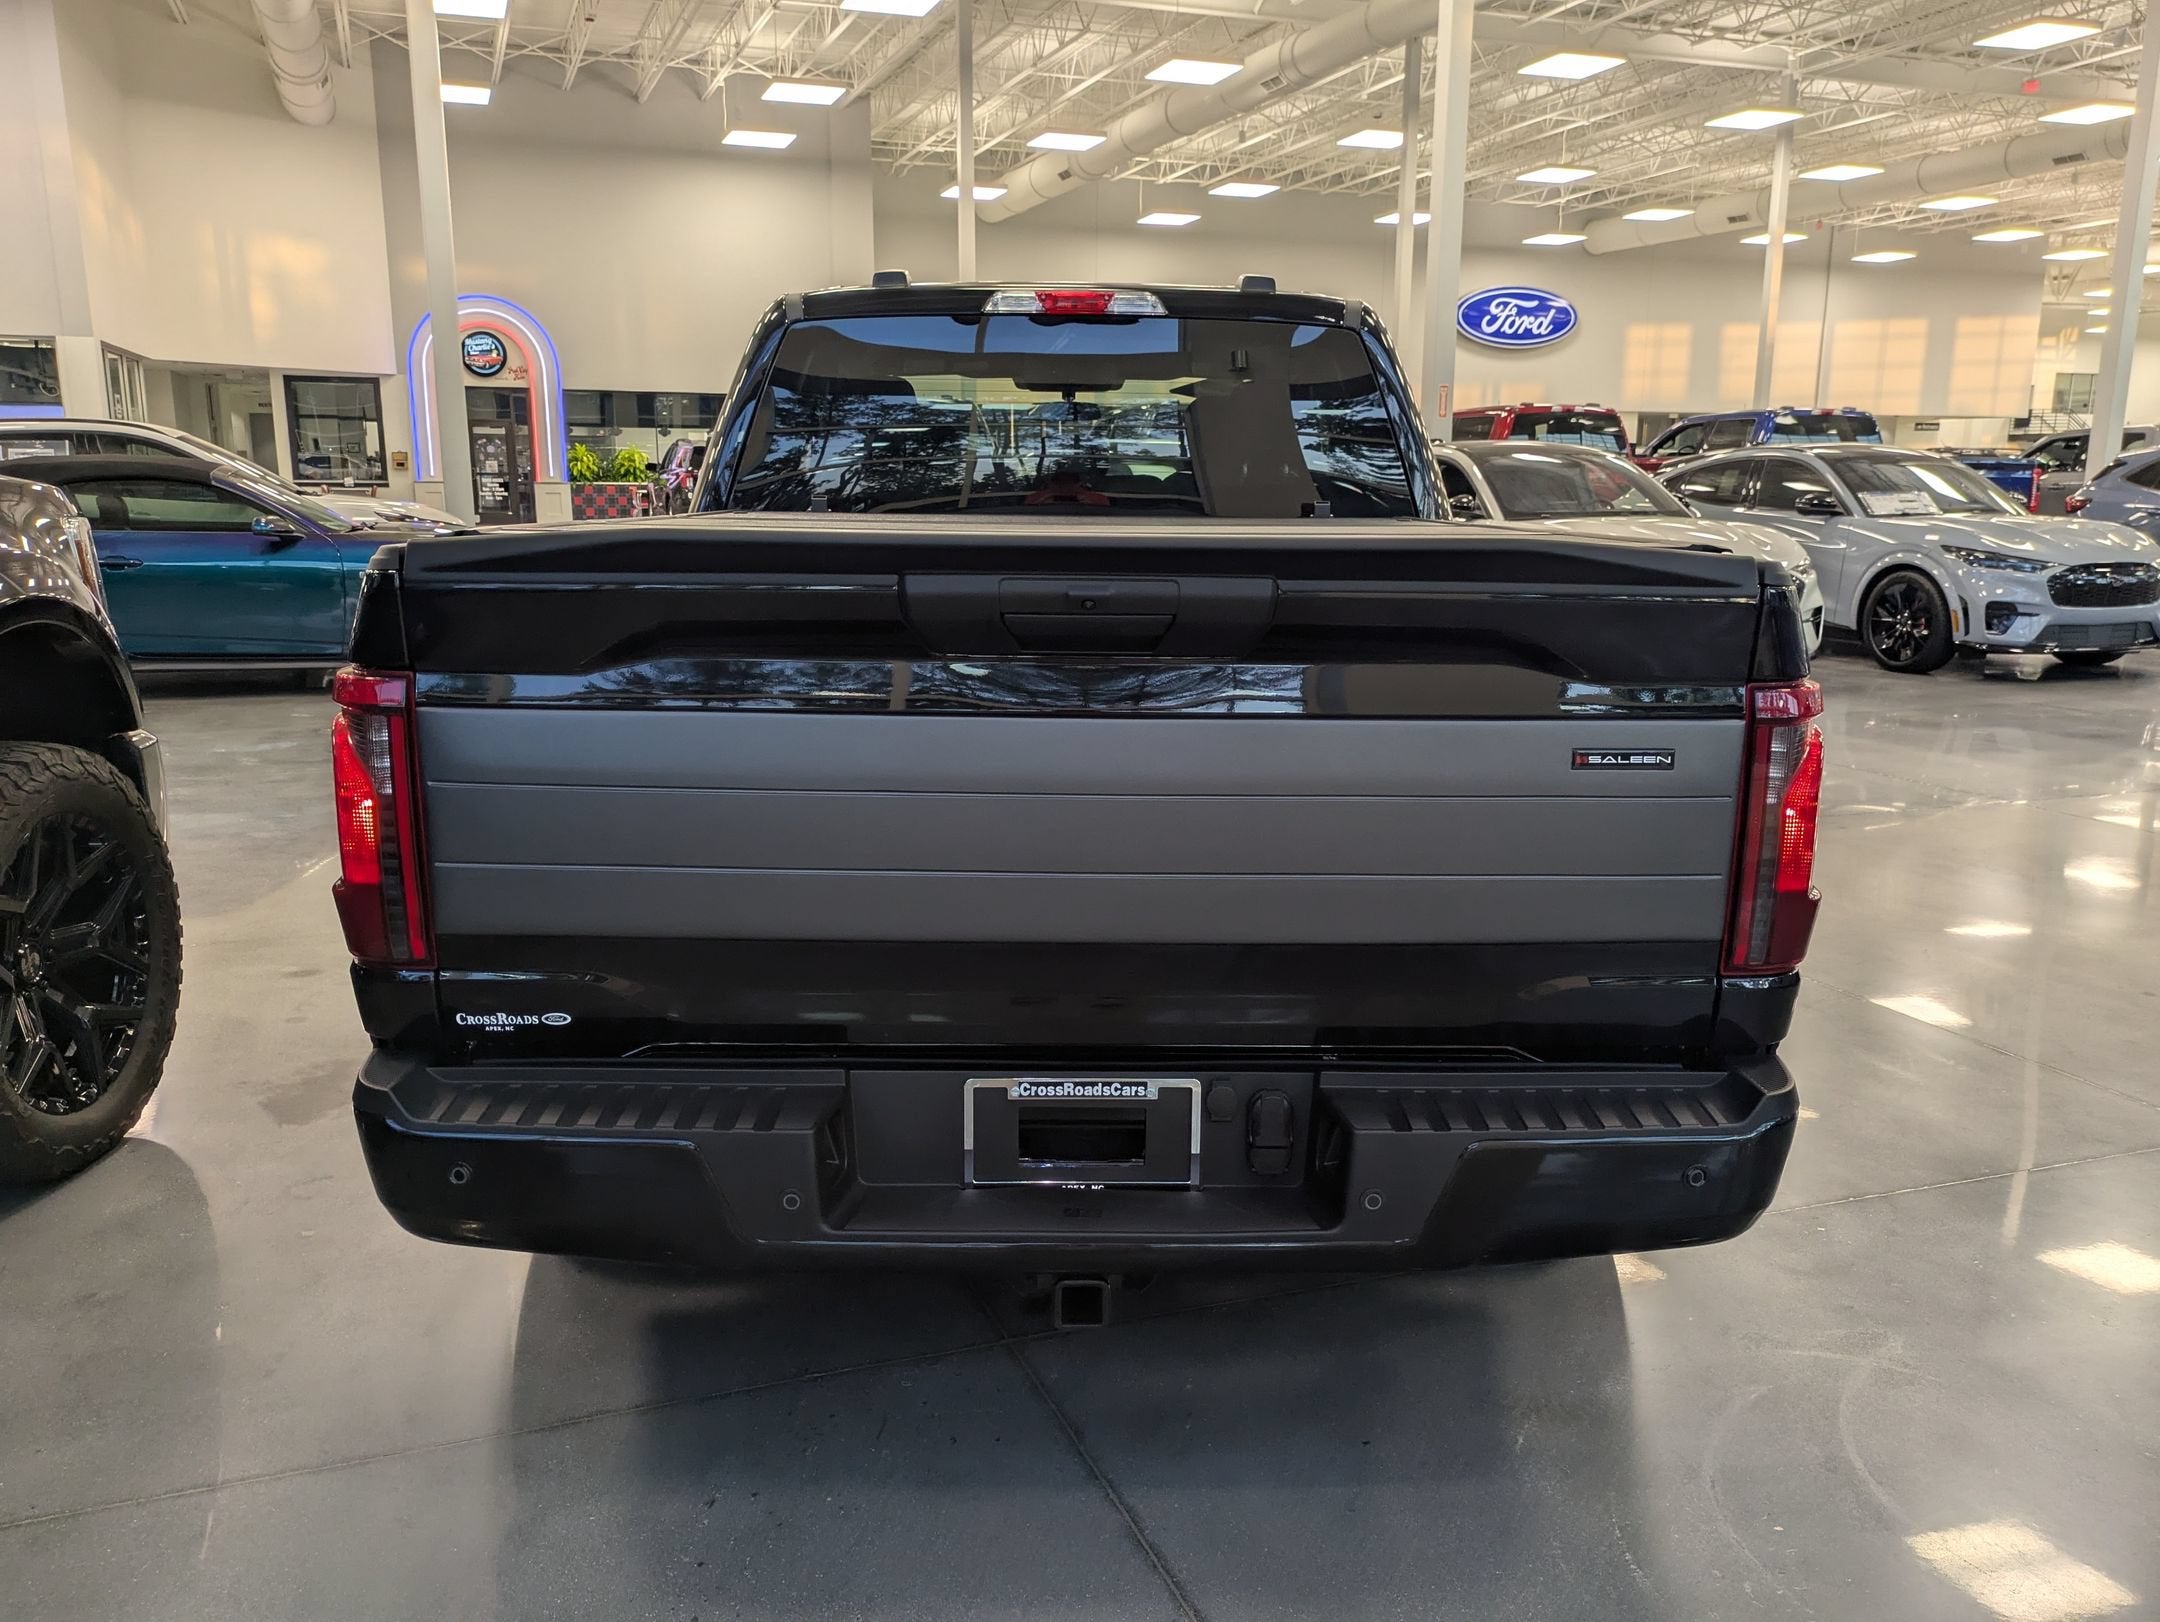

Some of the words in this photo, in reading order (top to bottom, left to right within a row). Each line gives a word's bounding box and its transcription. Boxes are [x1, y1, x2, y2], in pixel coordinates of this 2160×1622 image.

[1481, 297, 1556, 335] Ford
[1588, 755, 1672, 764] SALEEN
[1019, 1082, 1146, 1097] CrossRoadsCars
